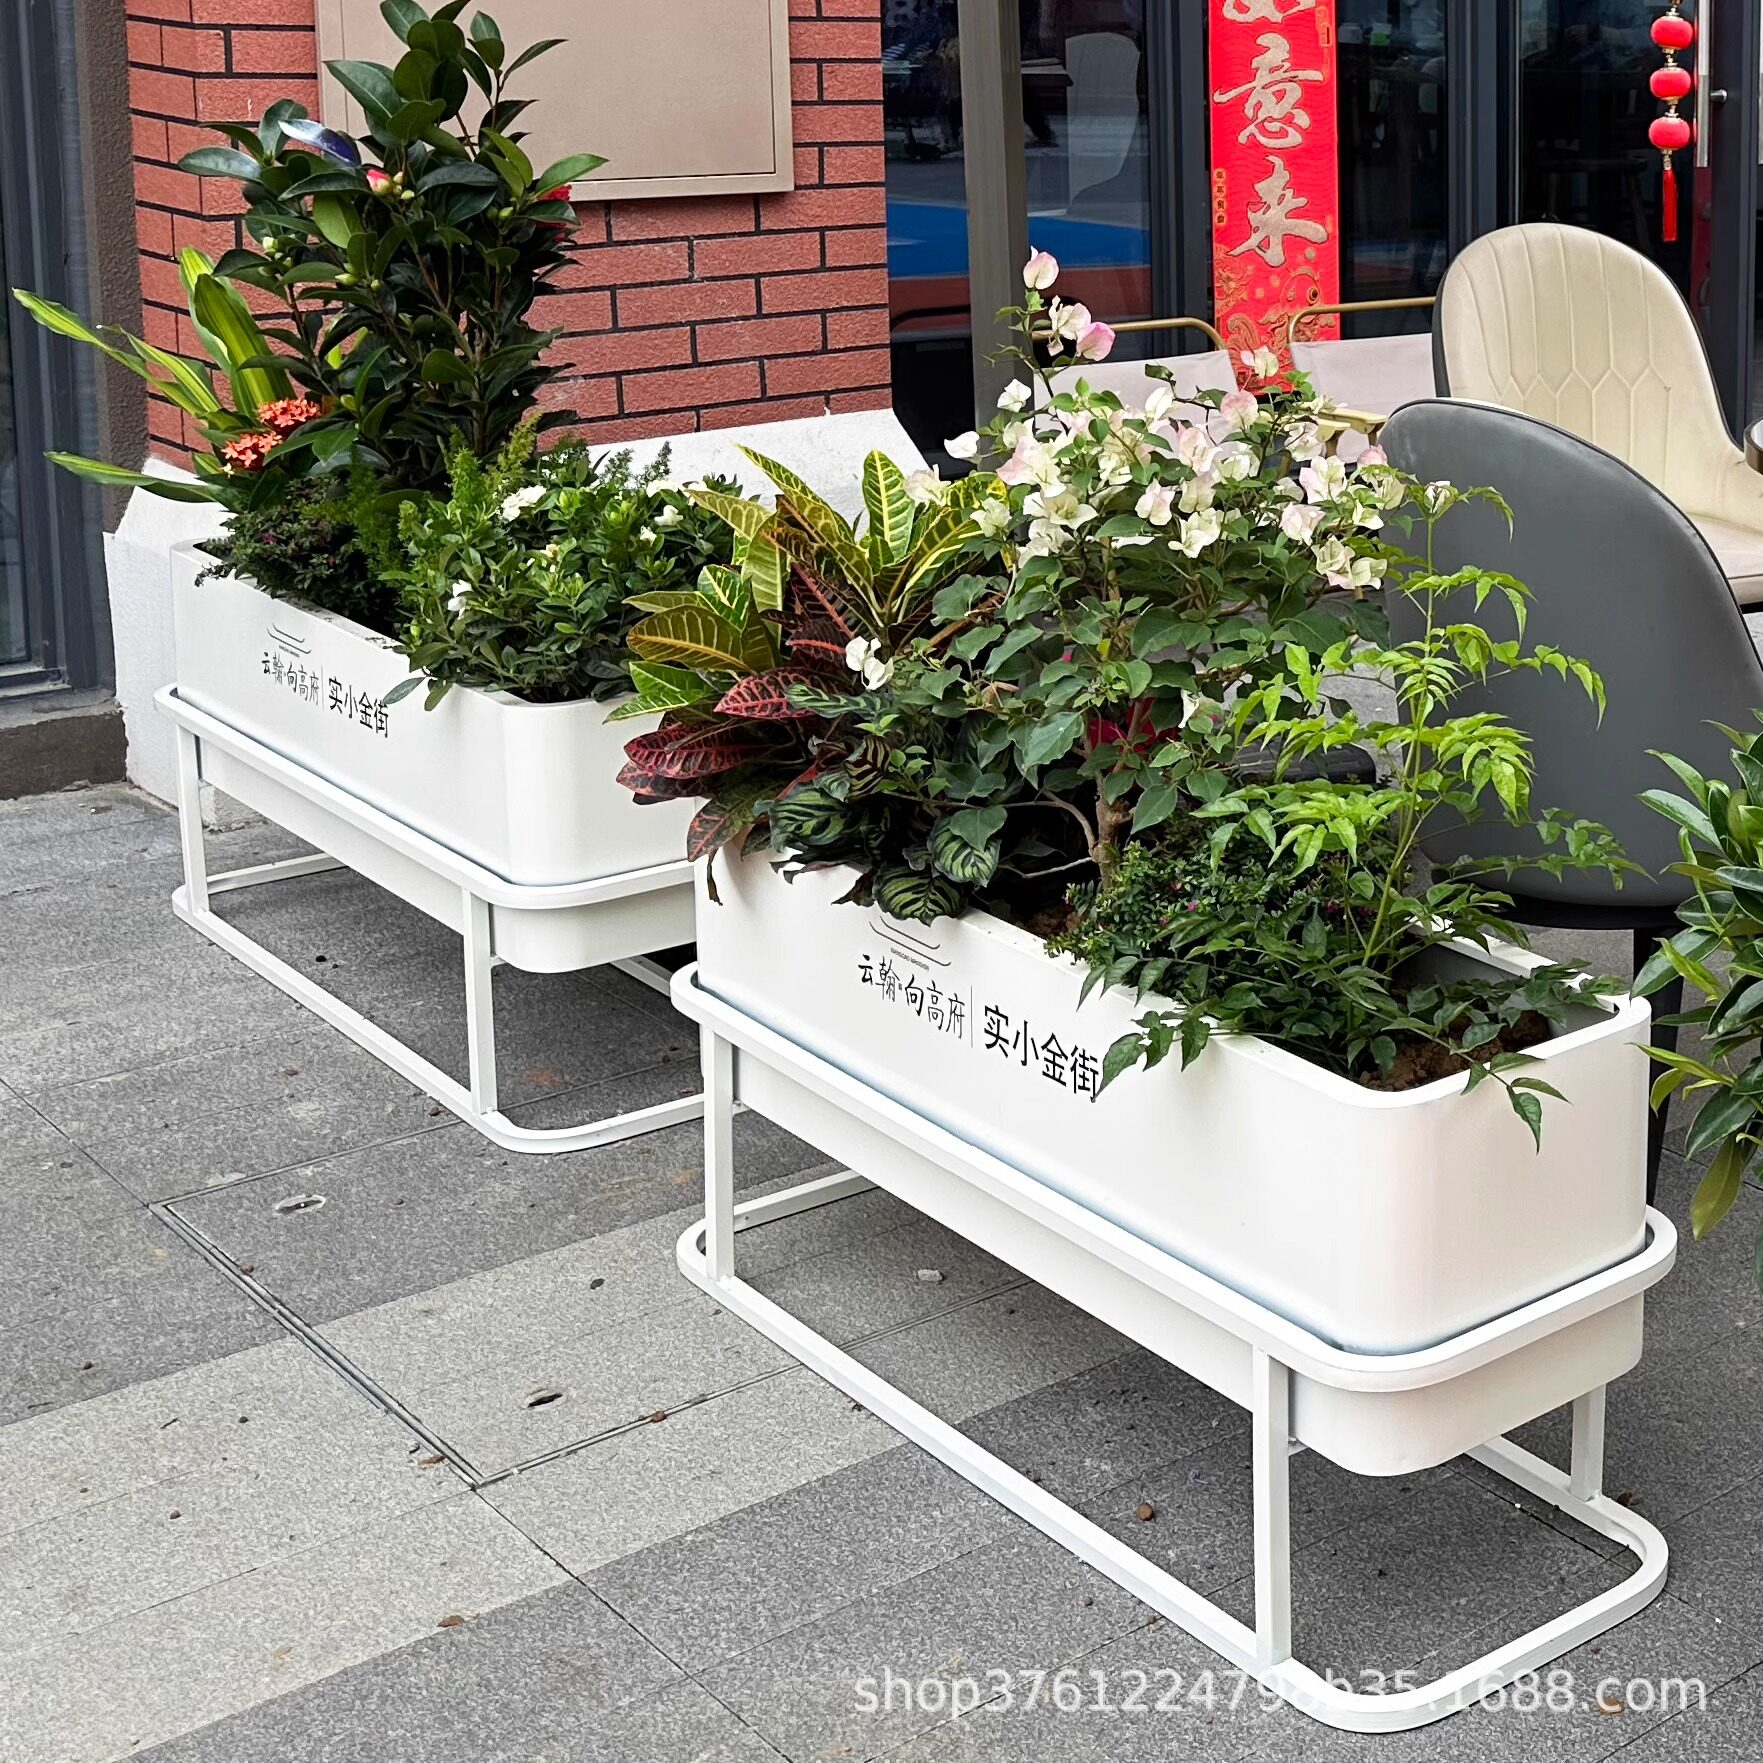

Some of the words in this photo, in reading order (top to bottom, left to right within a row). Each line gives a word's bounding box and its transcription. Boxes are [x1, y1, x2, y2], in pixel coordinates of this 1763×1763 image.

[1213, 0, 1329, 267] 意来
[328, 676, 389, 738] 实小金街
[983, 1004, 1099, 1103] 实小金街
